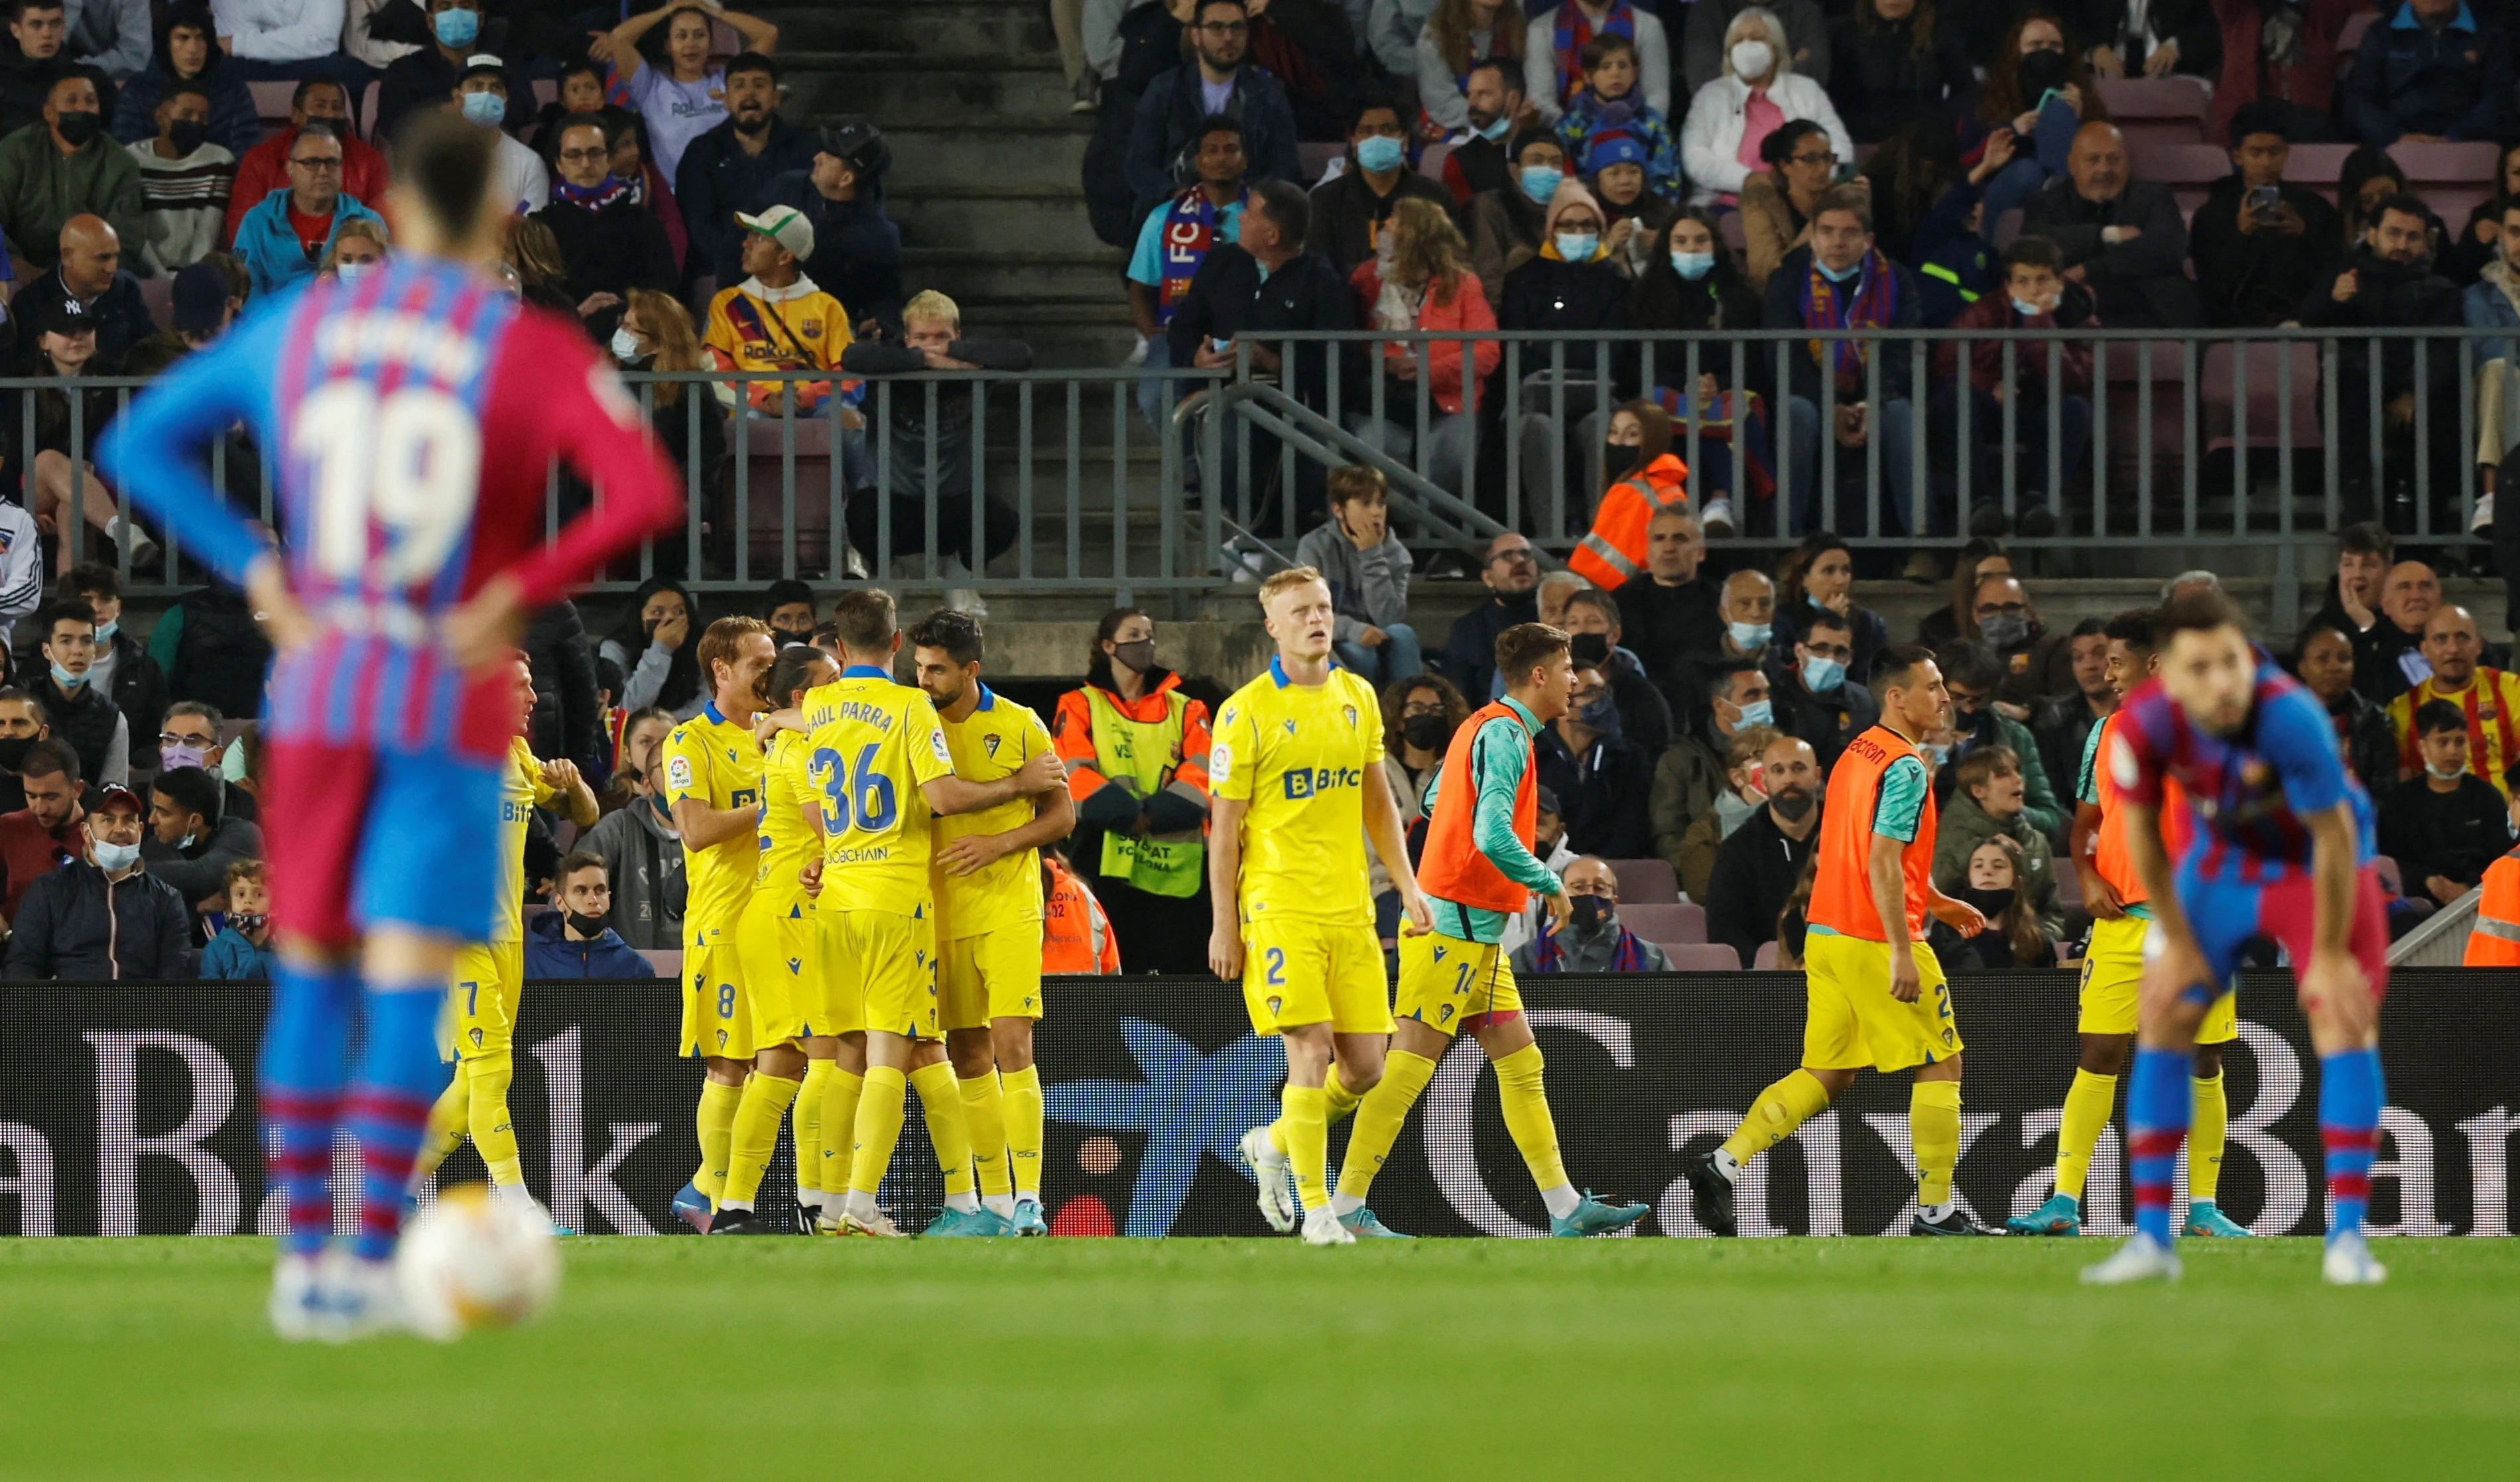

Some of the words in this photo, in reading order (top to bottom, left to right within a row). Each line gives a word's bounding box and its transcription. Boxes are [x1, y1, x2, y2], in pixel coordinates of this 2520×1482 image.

[1169, 221, 1200, 263] FC
[289, 376, 485, 587] 19
[840, 702, 893, 733] PARRA
[814, 743, 897, 837] 36
[1265, 947, 1285, 985] 2
[458, 981, 477, 1018] 7
[717, 983, 736, 1019] 8
[1934, 983, 1951, 1019] 2
